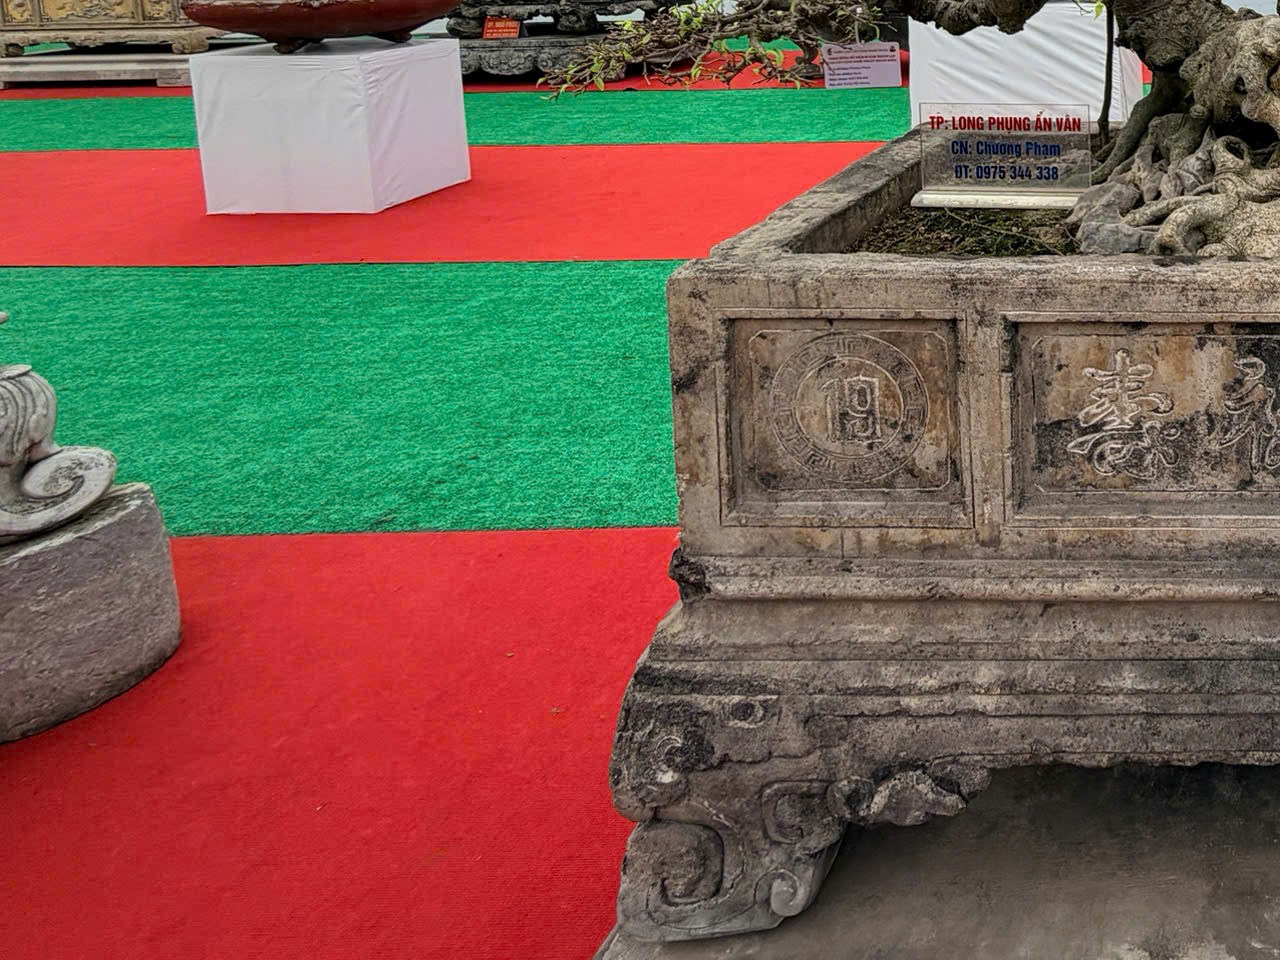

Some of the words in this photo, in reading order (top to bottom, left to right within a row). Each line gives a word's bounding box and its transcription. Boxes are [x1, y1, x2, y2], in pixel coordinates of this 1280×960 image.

[929, 116, 948, 130] TP:
[952, 116, 984, 130] LONG
[988, 116, 1031, 134] PHỤNG
[1056, 114, 1081, 131] VÂN
[951, 141, 972, 155] CN:
[976, 141, 1022, 157] Chương
[1025, 142, 1061, 159] Phạm
[955, 164, 972, 179] ĐT:
[976, 165, 1006, 179] 0975
[1010, 166, 1032, 179] 344
[1036, 166, 1059, 180] 338
